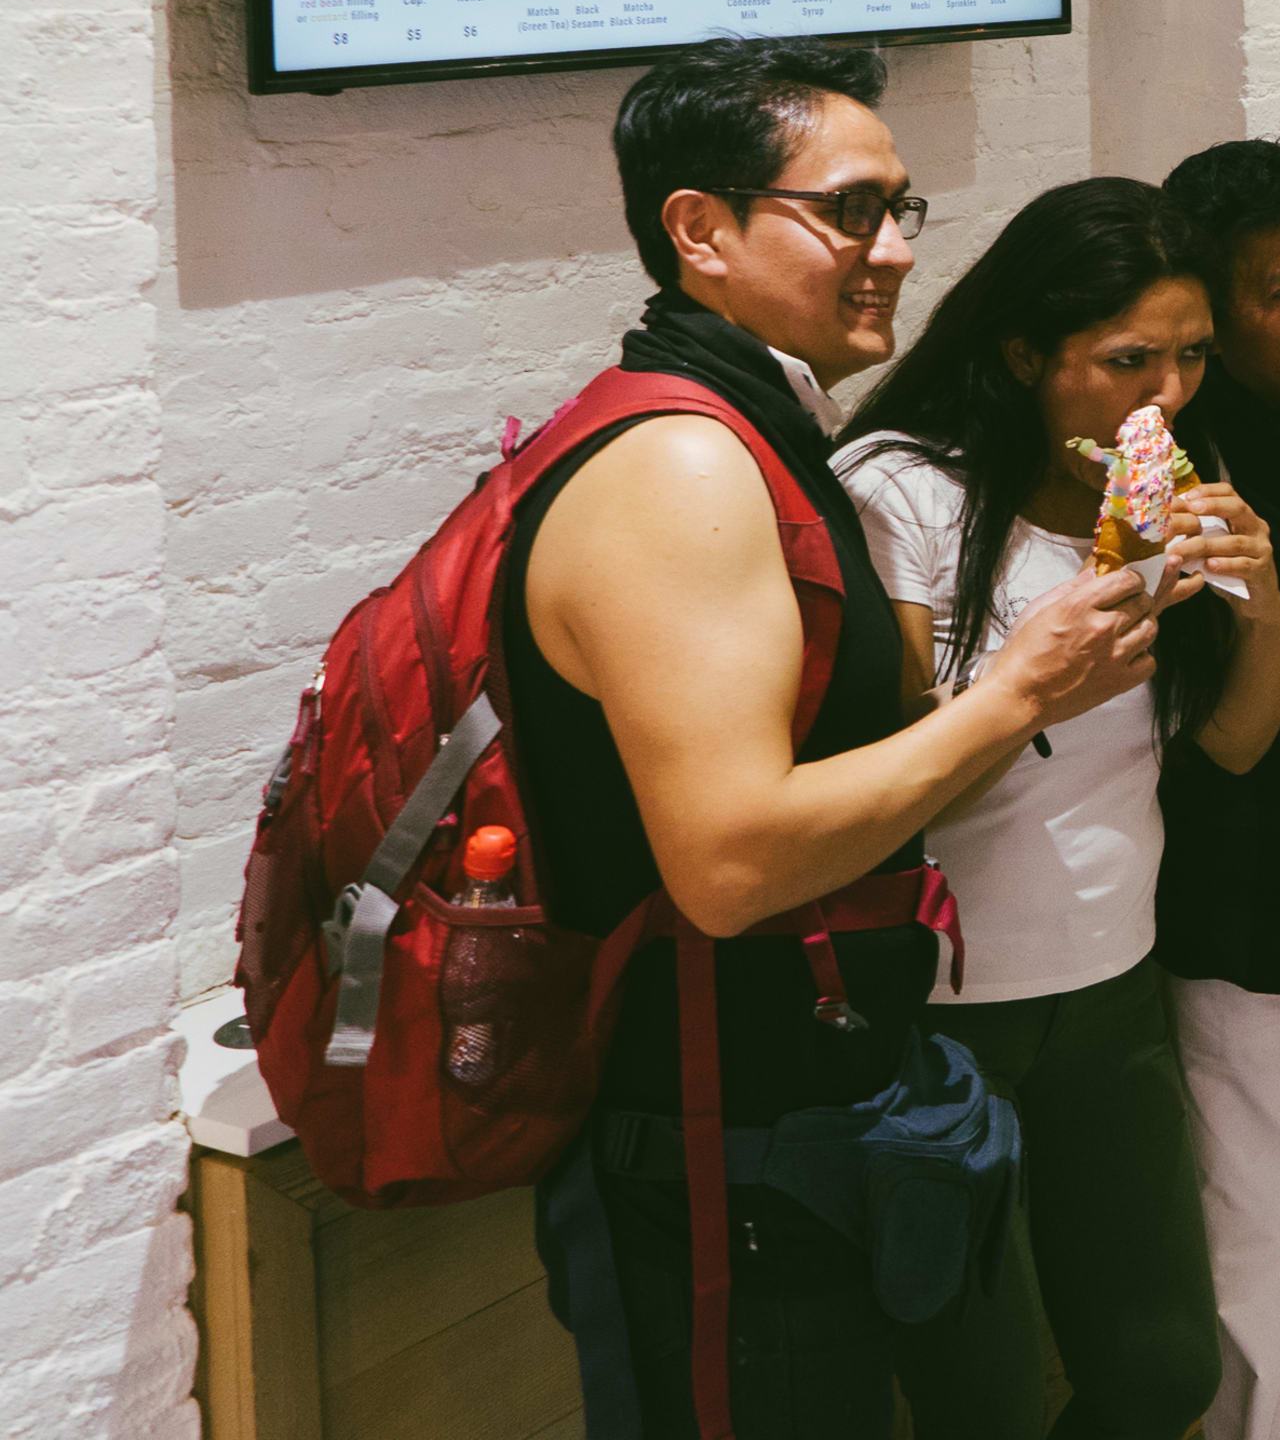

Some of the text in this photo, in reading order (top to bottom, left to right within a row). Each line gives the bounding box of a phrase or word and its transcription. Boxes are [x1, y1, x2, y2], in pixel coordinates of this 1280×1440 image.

[407, 28, 422, 41] $5
[463, 25, 478, 38] $6
[333, 32, 349, 46] $8
